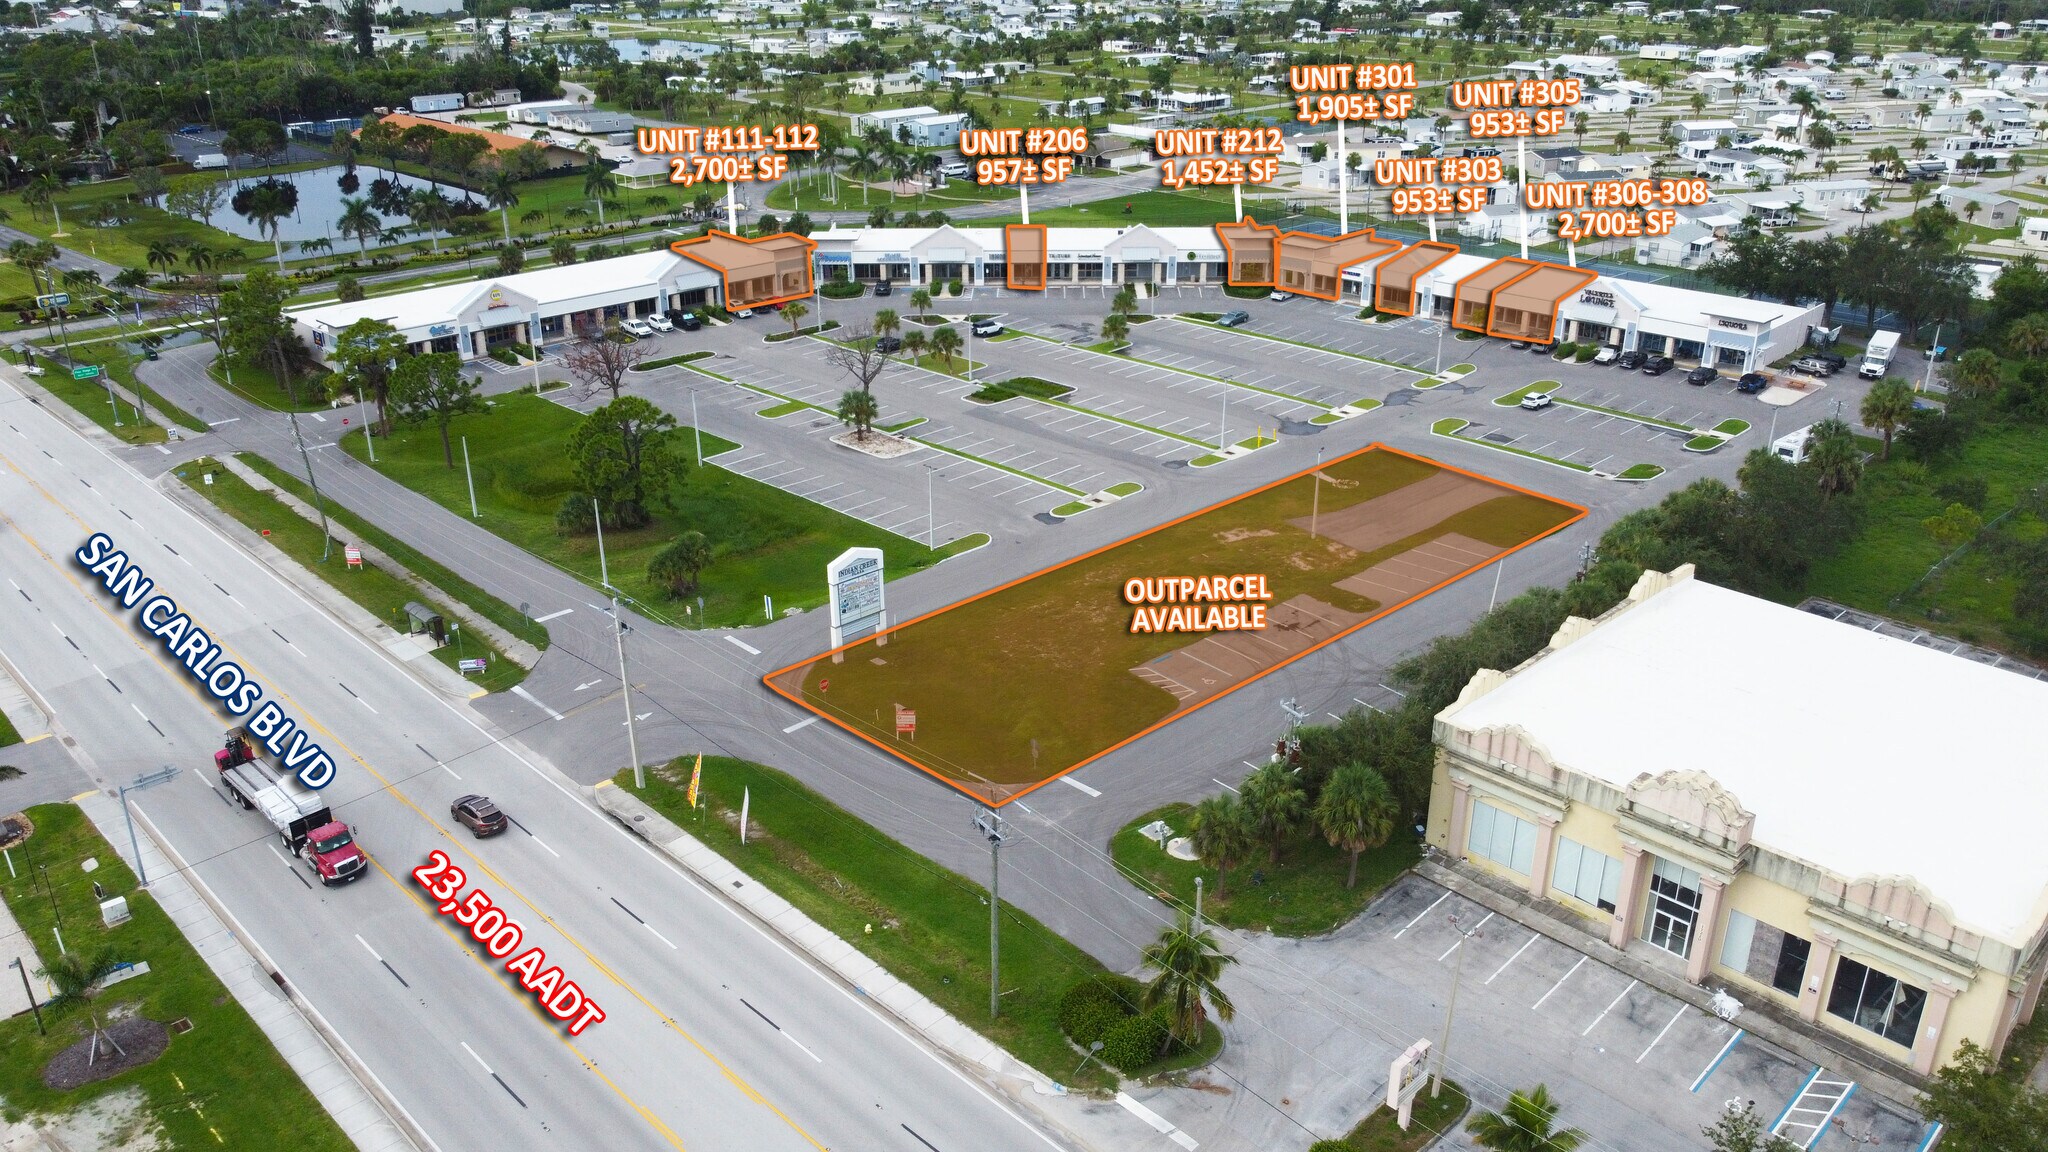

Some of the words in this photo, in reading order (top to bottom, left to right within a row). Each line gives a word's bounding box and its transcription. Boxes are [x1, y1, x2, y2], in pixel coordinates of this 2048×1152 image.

[1579, 294, 1616, 309] LOUNGE
[838, 565, 860, 578] INDIAN
[860, 559, 878, 571] CREEK
